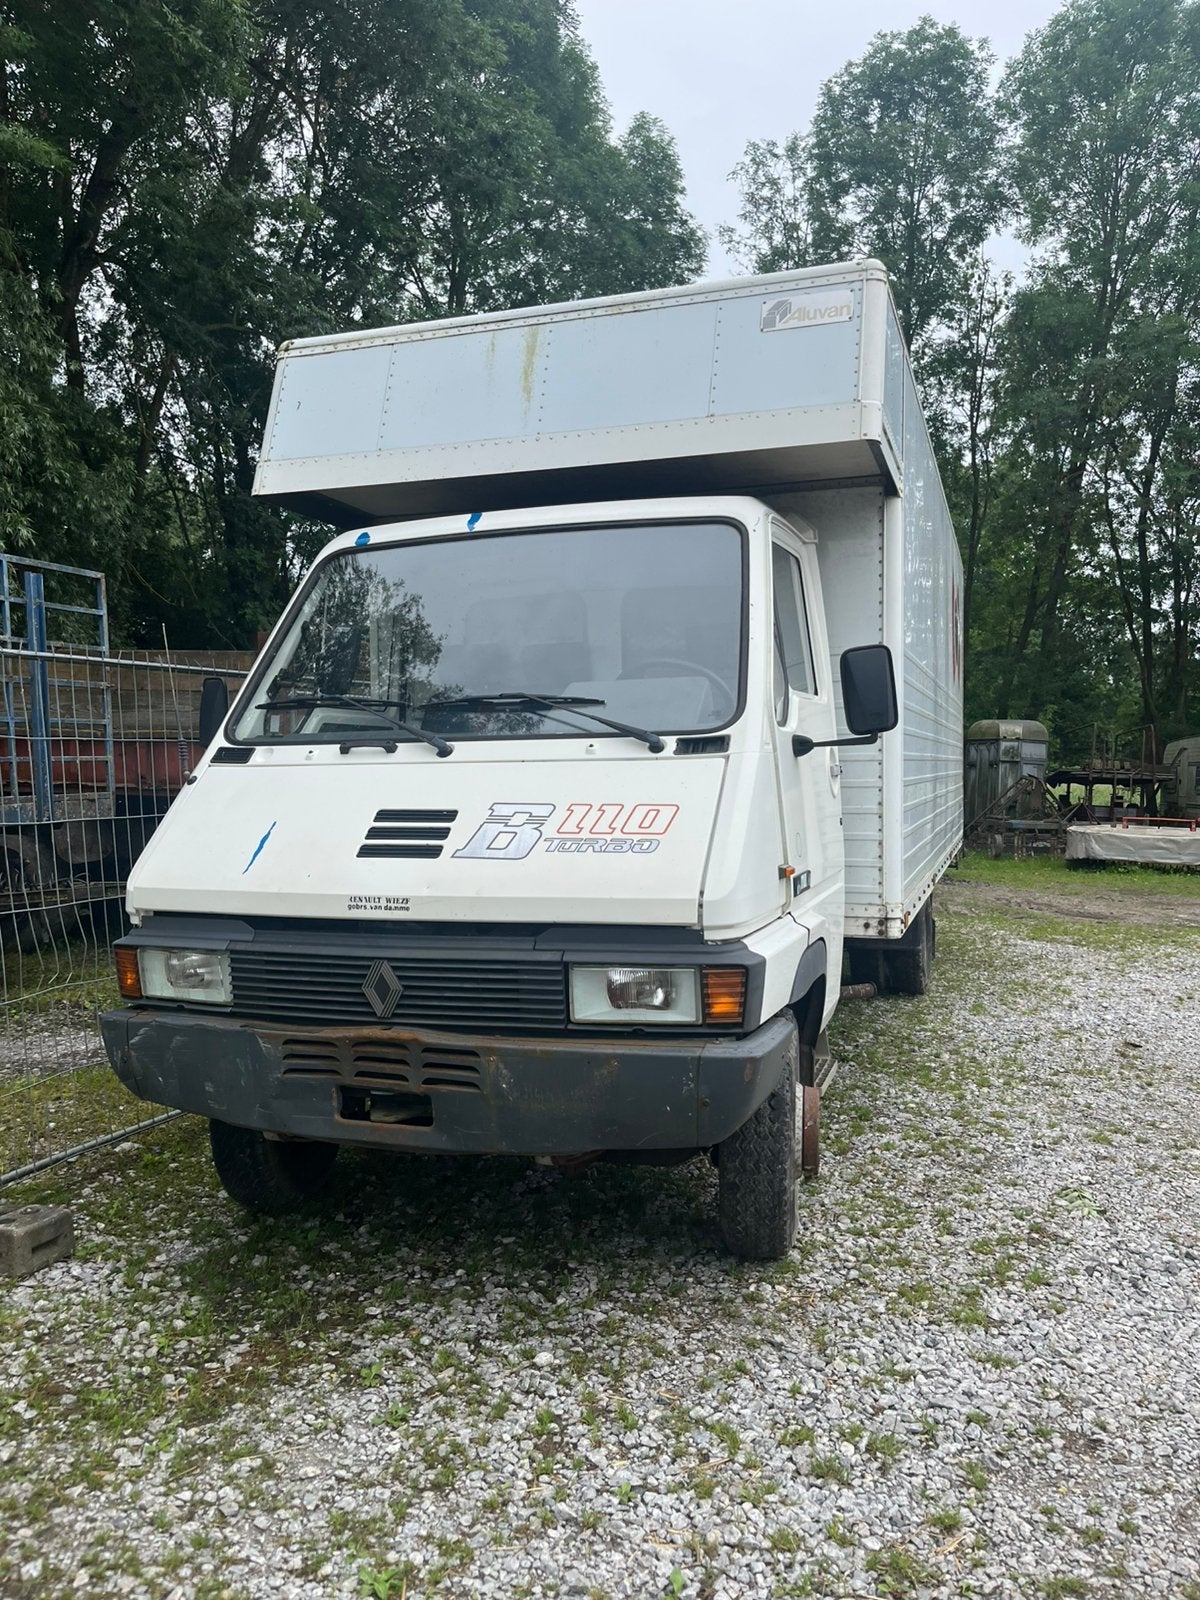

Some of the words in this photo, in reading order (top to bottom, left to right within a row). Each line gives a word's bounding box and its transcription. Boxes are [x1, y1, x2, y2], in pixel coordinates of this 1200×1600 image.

[782, 304, 851, 324] Aluvan
[450, 802, 556, 860] B
[556, 803, 680, 835] 110
[543, 837, 661, 854] TURBO
